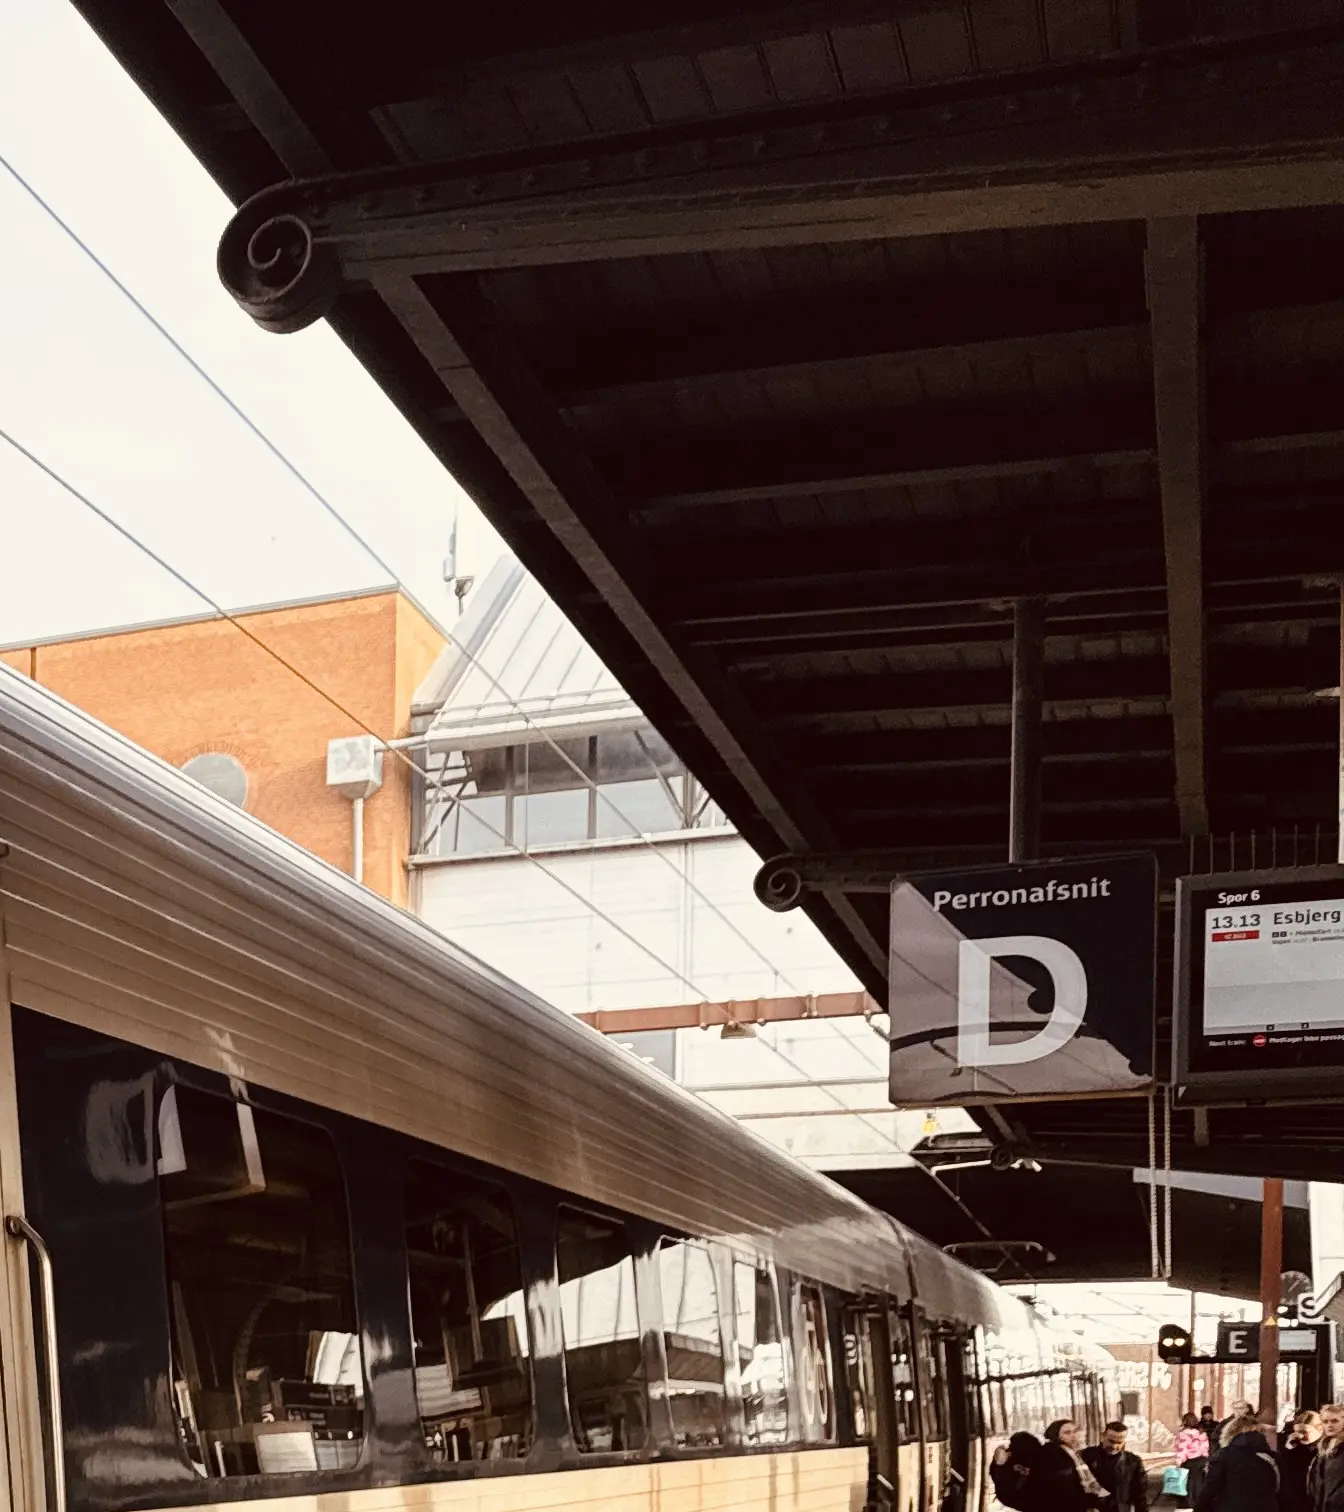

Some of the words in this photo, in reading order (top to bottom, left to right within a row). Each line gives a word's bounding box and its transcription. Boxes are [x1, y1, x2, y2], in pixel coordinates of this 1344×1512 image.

[933, 877, 1112, 912] Perronafsnit
[1217, 892, 1248, 906] Spor
[1250, 889, 1261, 901] 6
[1211, 913, 1261, 929] 13.13
[1273, 908, 1341, 925] Esbjerg
[958, 935, 1088, 1068] D
[1229, 1330, 1248, 1354] E
